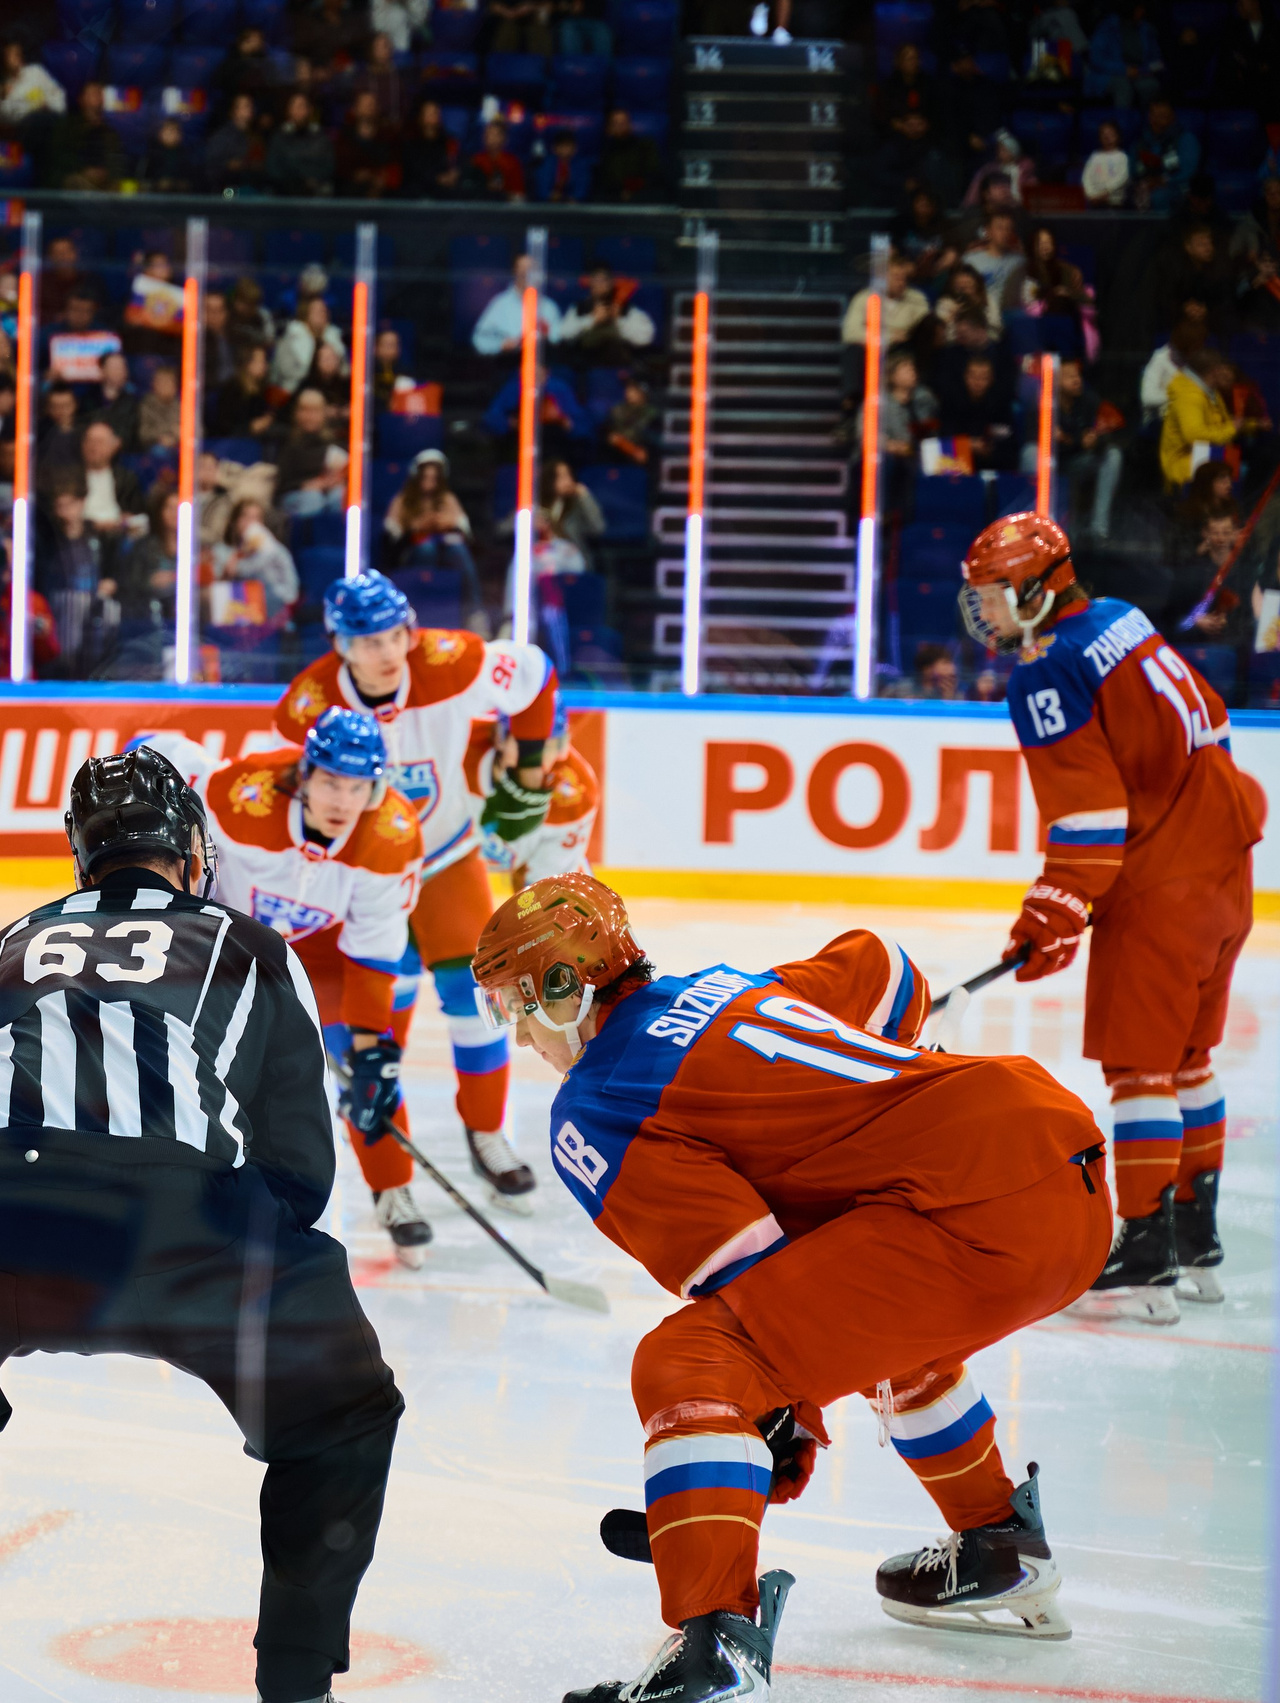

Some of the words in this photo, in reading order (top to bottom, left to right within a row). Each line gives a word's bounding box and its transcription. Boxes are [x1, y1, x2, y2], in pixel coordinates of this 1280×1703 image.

[1027, 688, 1066, 738] 13
[23, 920, 175, 984] 63
[517, 930, 555, 955] BAUER
[727, 996, 924, 1084] 18
[554, 1120, 608, 1196] 18
[937, 1581, 980, 1600] BAUER
[640, 1684, 685, 1702] AUER
